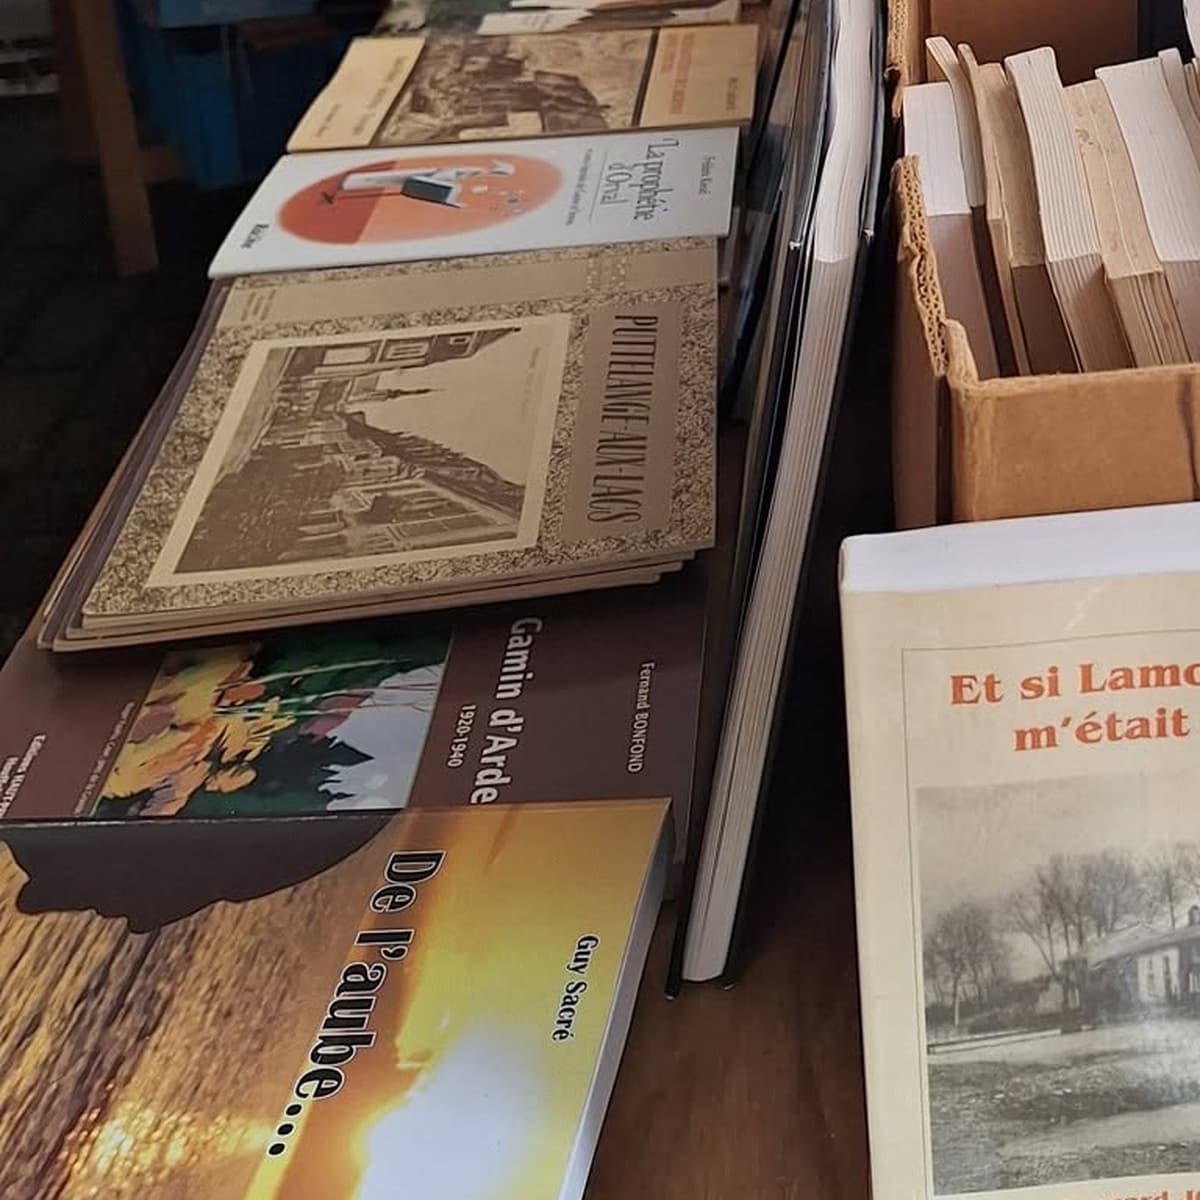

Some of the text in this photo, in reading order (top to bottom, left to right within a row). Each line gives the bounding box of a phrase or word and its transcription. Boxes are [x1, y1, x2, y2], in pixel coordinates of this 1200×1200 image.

[628, 161, 675, 221] prophétie
[496, 616, 544, 699] Gamin
[949, 673, 1004, 706] Et
[1020, 666, 1060, 700] si
[447, 703, 477, 768] 1920-1940
[627, 661, 656, 773] Fernand BONFOND
[1013, 706, 1191, 752] m'était
[370, 850, 448, 913] De
[551, 933, 600, 1043] Guy Sacré
